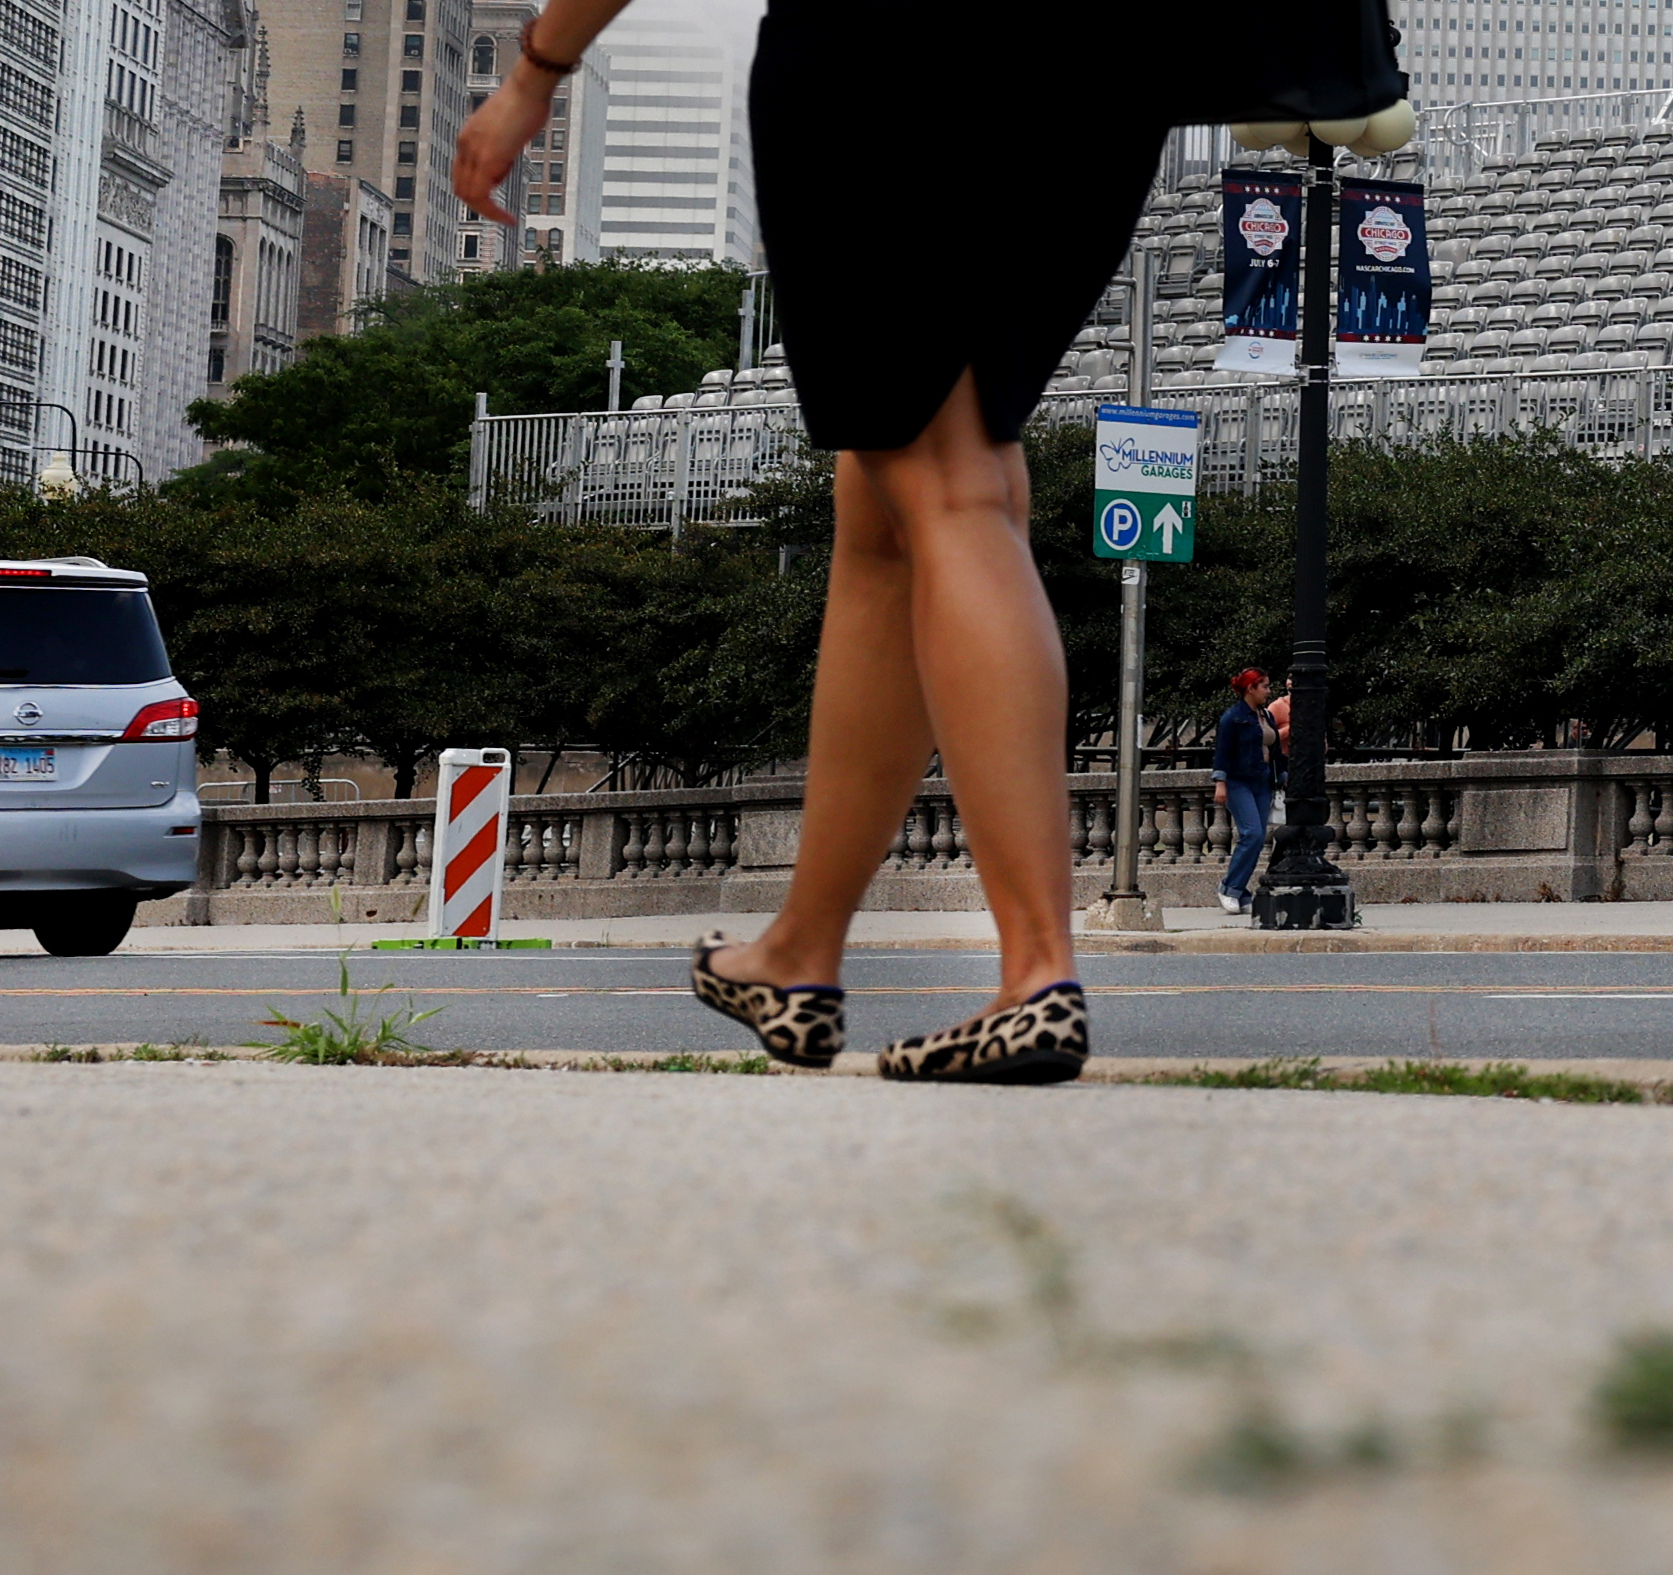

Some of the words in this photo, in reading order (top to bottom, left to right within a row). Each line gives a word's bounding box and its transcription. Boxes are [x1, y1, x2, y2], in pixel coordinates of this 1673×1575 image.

[1245, 222, 1282, 232] CHICAGO
[1365, 229, 1405, 239] CHICAGO
[1249, 258, 1266, 267] JULY
[1267, 259, 1280, 268] 6-7
[1101, 408, 1195, 422] www.millenniumgarages.com
[1121, 448, 1194, 466] MILLENNIUM
[1141, 465, 1193, 480] GARAGES
[1112, 508, 1133, 541] P
[26, 757, 55, 773] 1405
